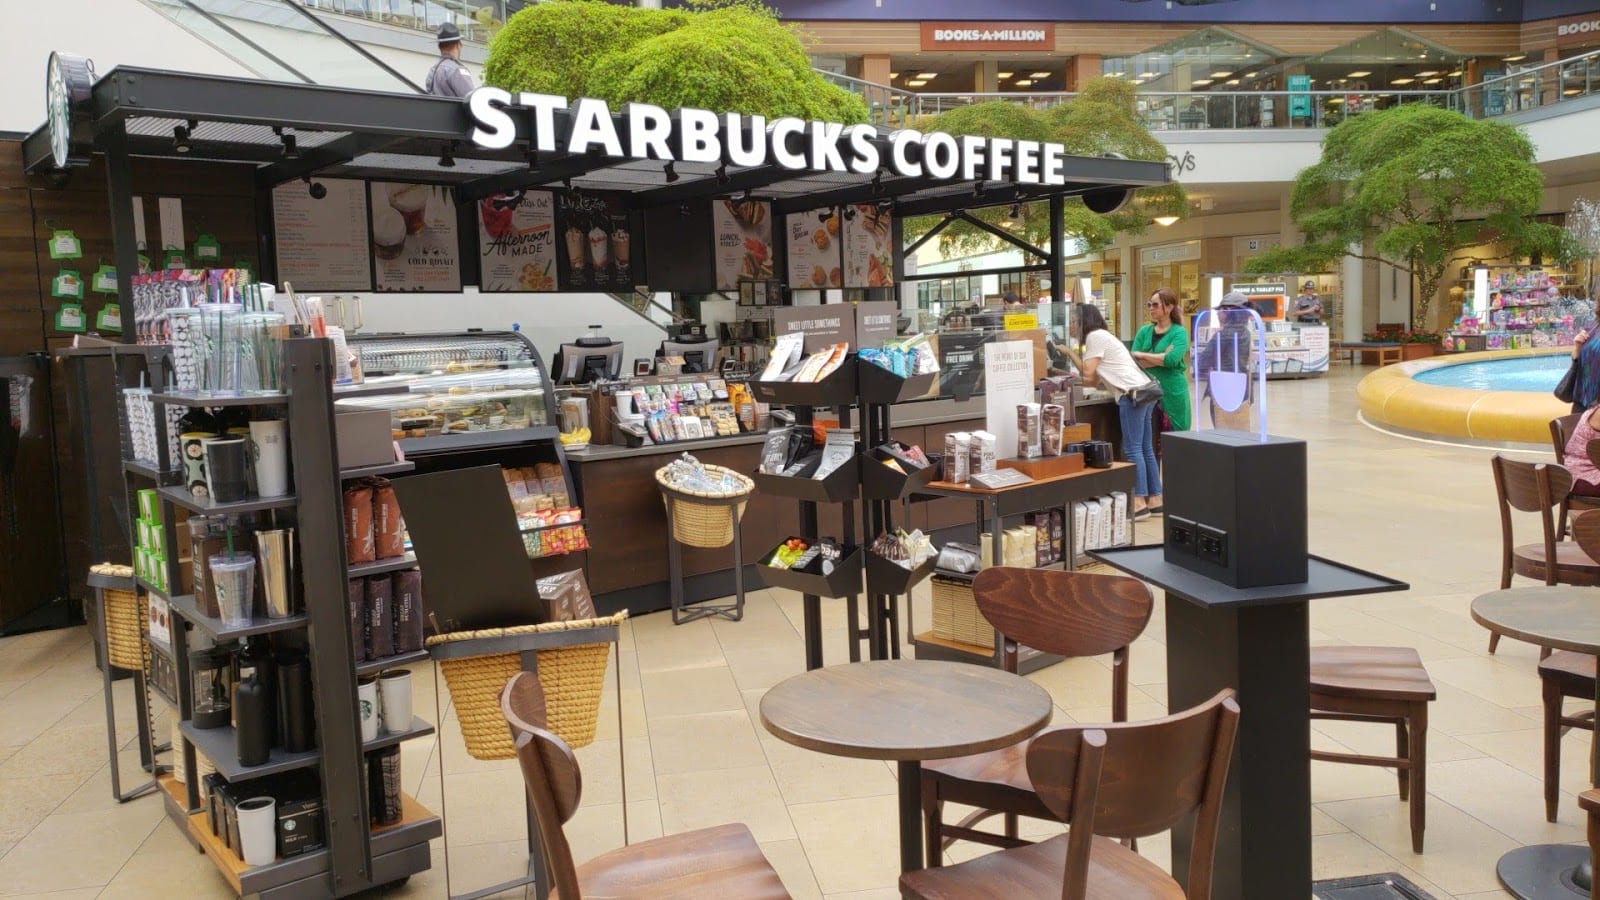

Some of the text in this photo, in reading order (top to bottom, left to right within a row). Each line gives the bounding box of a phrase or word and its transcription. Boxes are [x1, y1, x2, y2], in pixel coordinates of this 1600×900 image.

[469, 86, 1065, 186] STARBUCKS COFFEE
[482, 230, 553, 257] Afternoon
[511, 243, 544, 257] MADE
[408, 257, 427, 266] COLD
[945, 354, 974, 364] FREE DRINK
